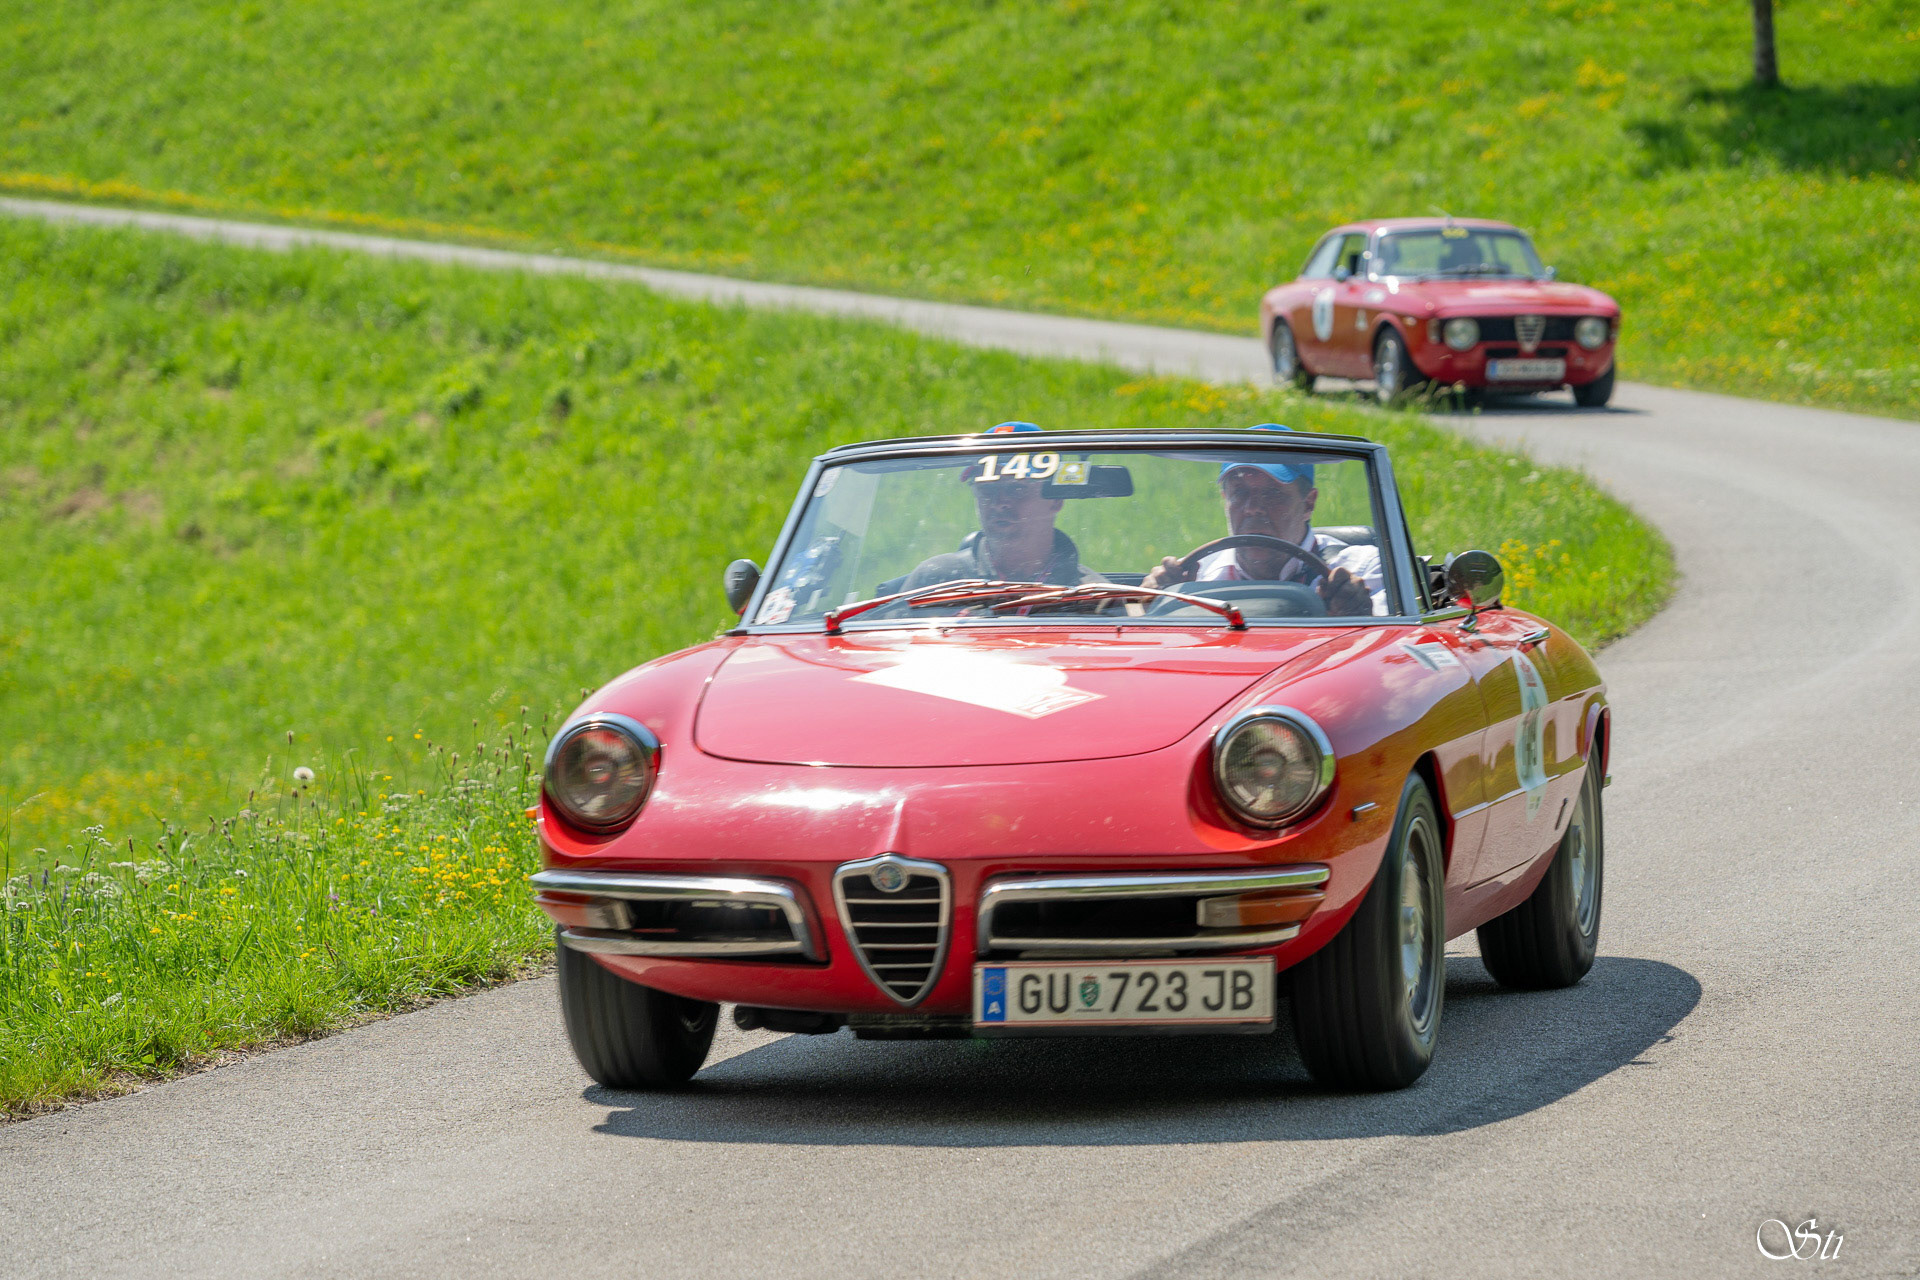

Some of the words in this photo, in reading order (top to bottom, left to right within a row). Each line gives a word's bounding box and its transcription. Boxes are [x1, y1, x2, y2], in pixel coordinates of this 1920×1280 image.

[974, 451, 1061, 482] 149
[1018, 972, 1071, 1014] GU
[1108, 971, 1188, 1013] 723
[1202, 970, 1255, 1012] JB
[987, 1001, 1002, 1015] A
